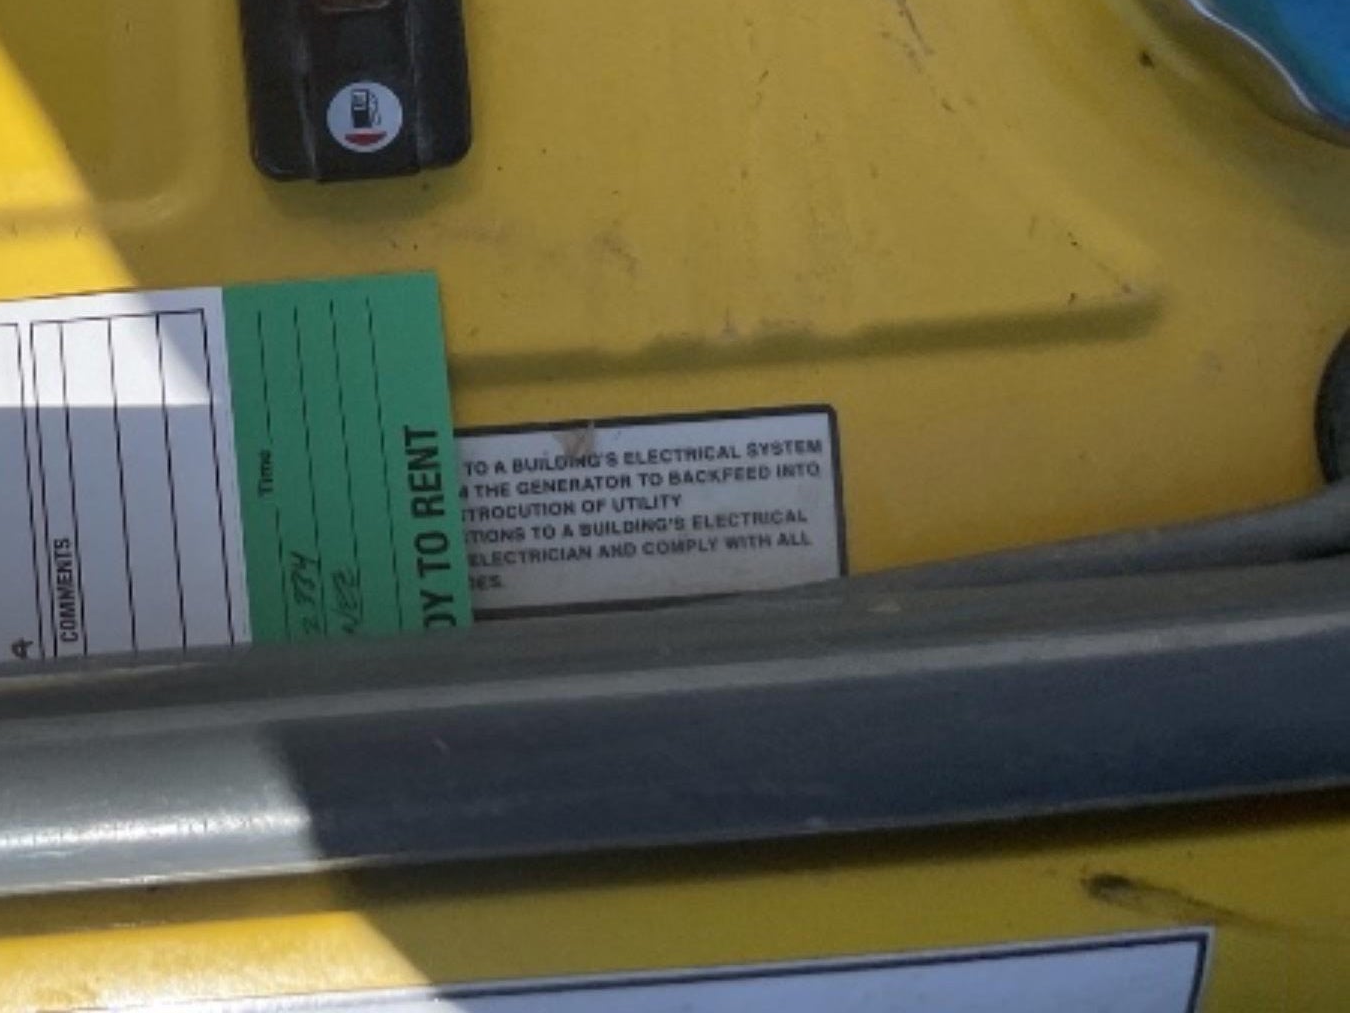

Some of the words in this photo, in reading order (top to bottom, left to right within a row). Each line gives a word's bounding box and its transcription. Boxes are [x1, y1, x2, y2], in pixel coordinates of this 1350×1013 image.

[256, 449, 274, 498] Time
[403, 424, 446, 519] RENT
[464, 460, 489, 477] TO
[494, 460, 507, 475] A
[512, 450, 619, 474] BUILDING'S
[623, 444, 741, 466] ELECTRICAL
[746, 439, 823, 459] SYSTEM
[474, 481, 511, 499] THE
[516, 473, 632, 495] GENERATOR
[637, 471, 664, 488] TO
[668, 464, 772, 486] BACKFEED
[776, 460, 820, 479] INTO
[581, 498, 607, 515] OF
[612, 492, 682, 514] UTILITY
[531, 524, 556, 541] TO
[561, 522, 574, 538] A
[691, 508, 808, 532] ELECTRICAL
[406, 531, 450, 579] TO
[599, 541, 637, 560] AND
[641, 536, 718, 556] COMPLY
[725, 532, 772, 550] WITH
[776, 529, 813, 547] ALL
[53, 537, 79, 643] COMMENTS
